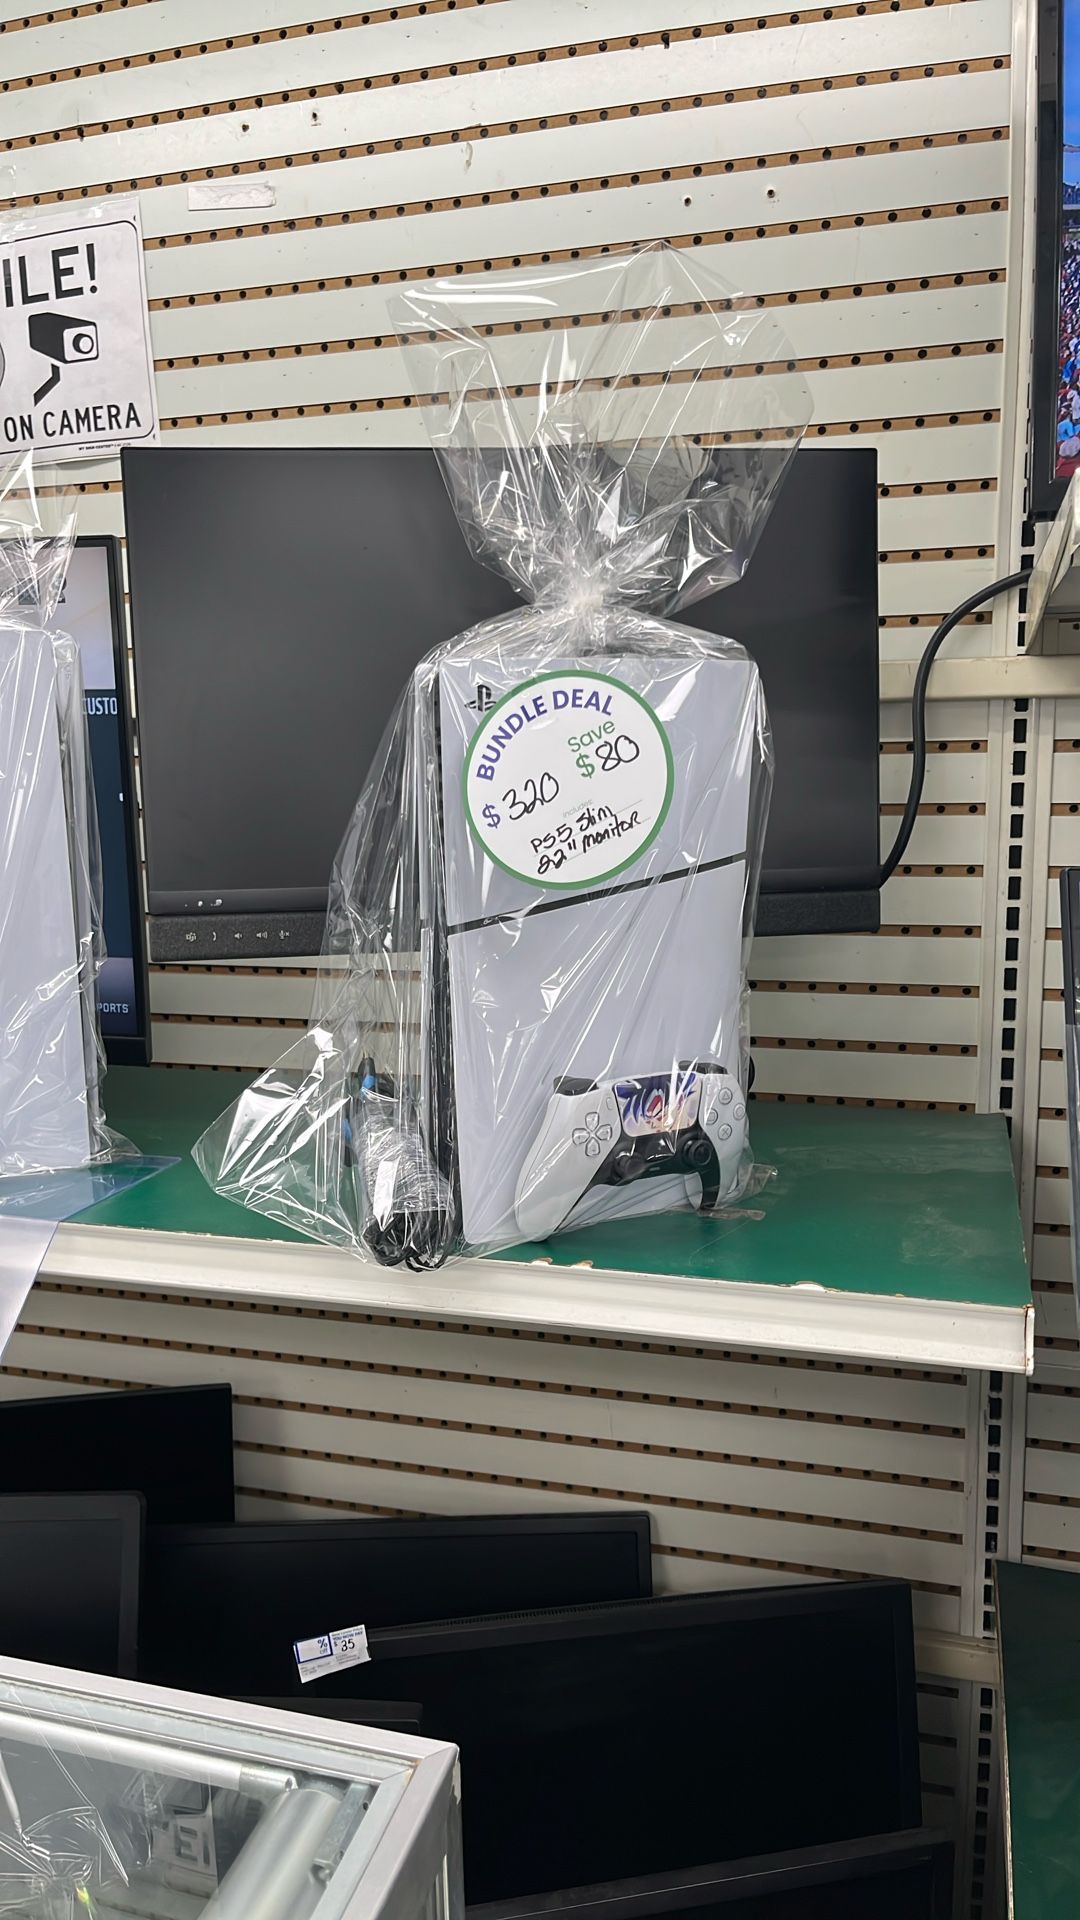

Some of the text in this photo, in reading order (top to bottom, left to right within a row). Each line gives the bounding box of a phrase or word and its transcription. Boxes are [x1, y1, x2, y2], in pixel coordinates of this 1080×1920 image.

[2, 243, 98, 308] ILE!
[4, 402, 142, 442] ON CAMERA
[476, 689, 613, 781] BUNDLE DEAL
[567, 721, 617, 753] Save
